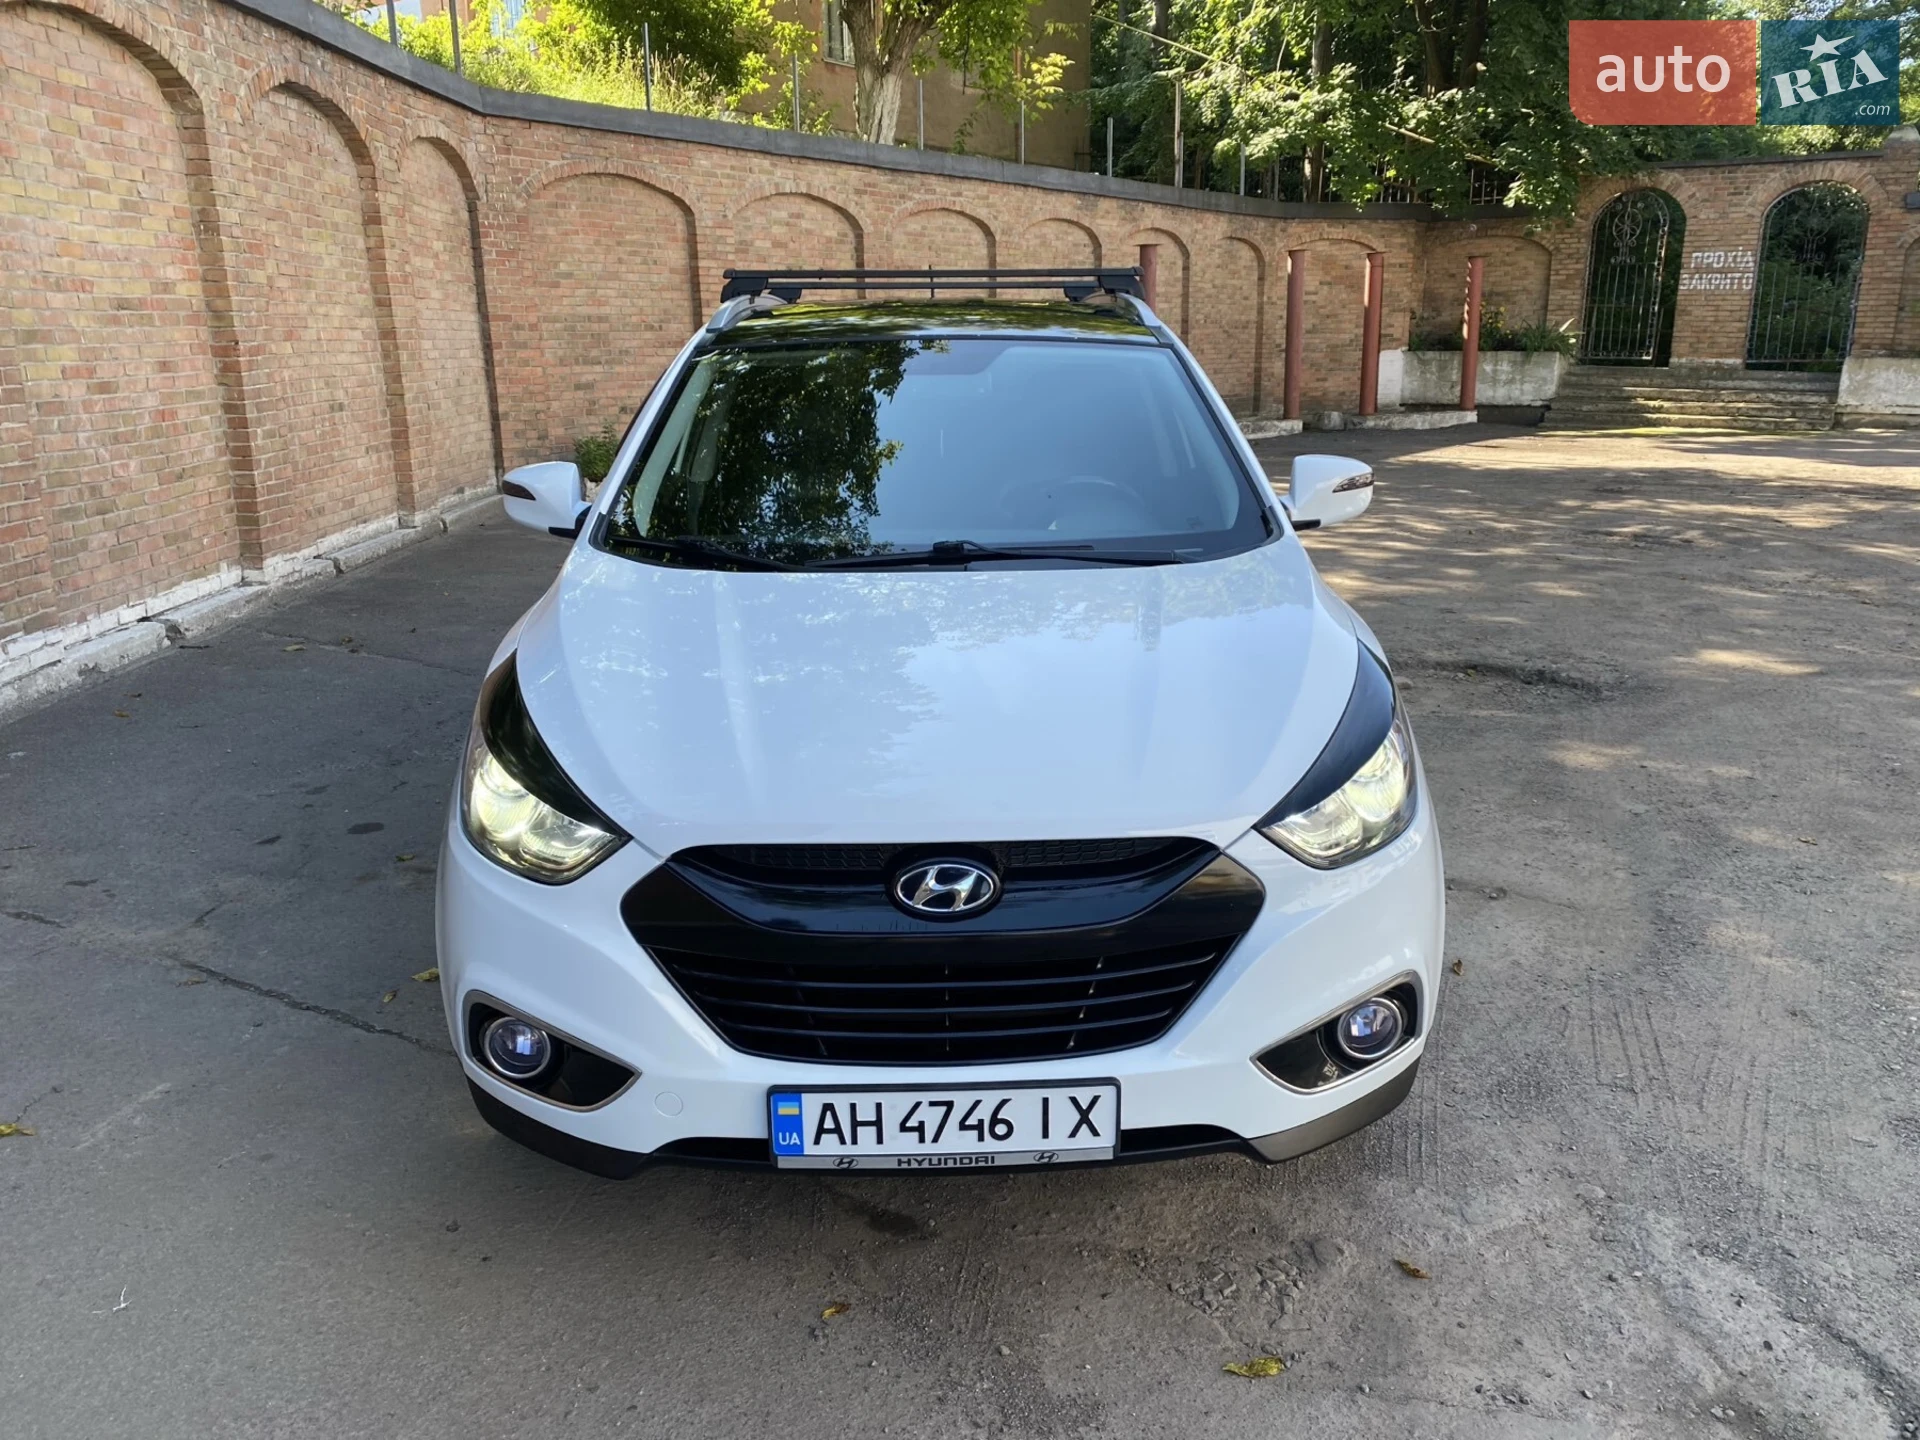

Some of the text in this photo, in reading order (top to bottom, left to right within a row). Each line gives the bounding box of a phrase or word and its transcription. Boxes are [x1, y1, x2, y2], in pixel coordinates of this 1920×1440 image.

[1680, 273, 1754, 290] ЗАКРИТО
[813, 1102, 884, 1145] AH
[899, 1099, 1014, 1143] 4746
[778, 1131, 800, 1146] UA
[897, 1156, 995, 1167] HYUNDAI
